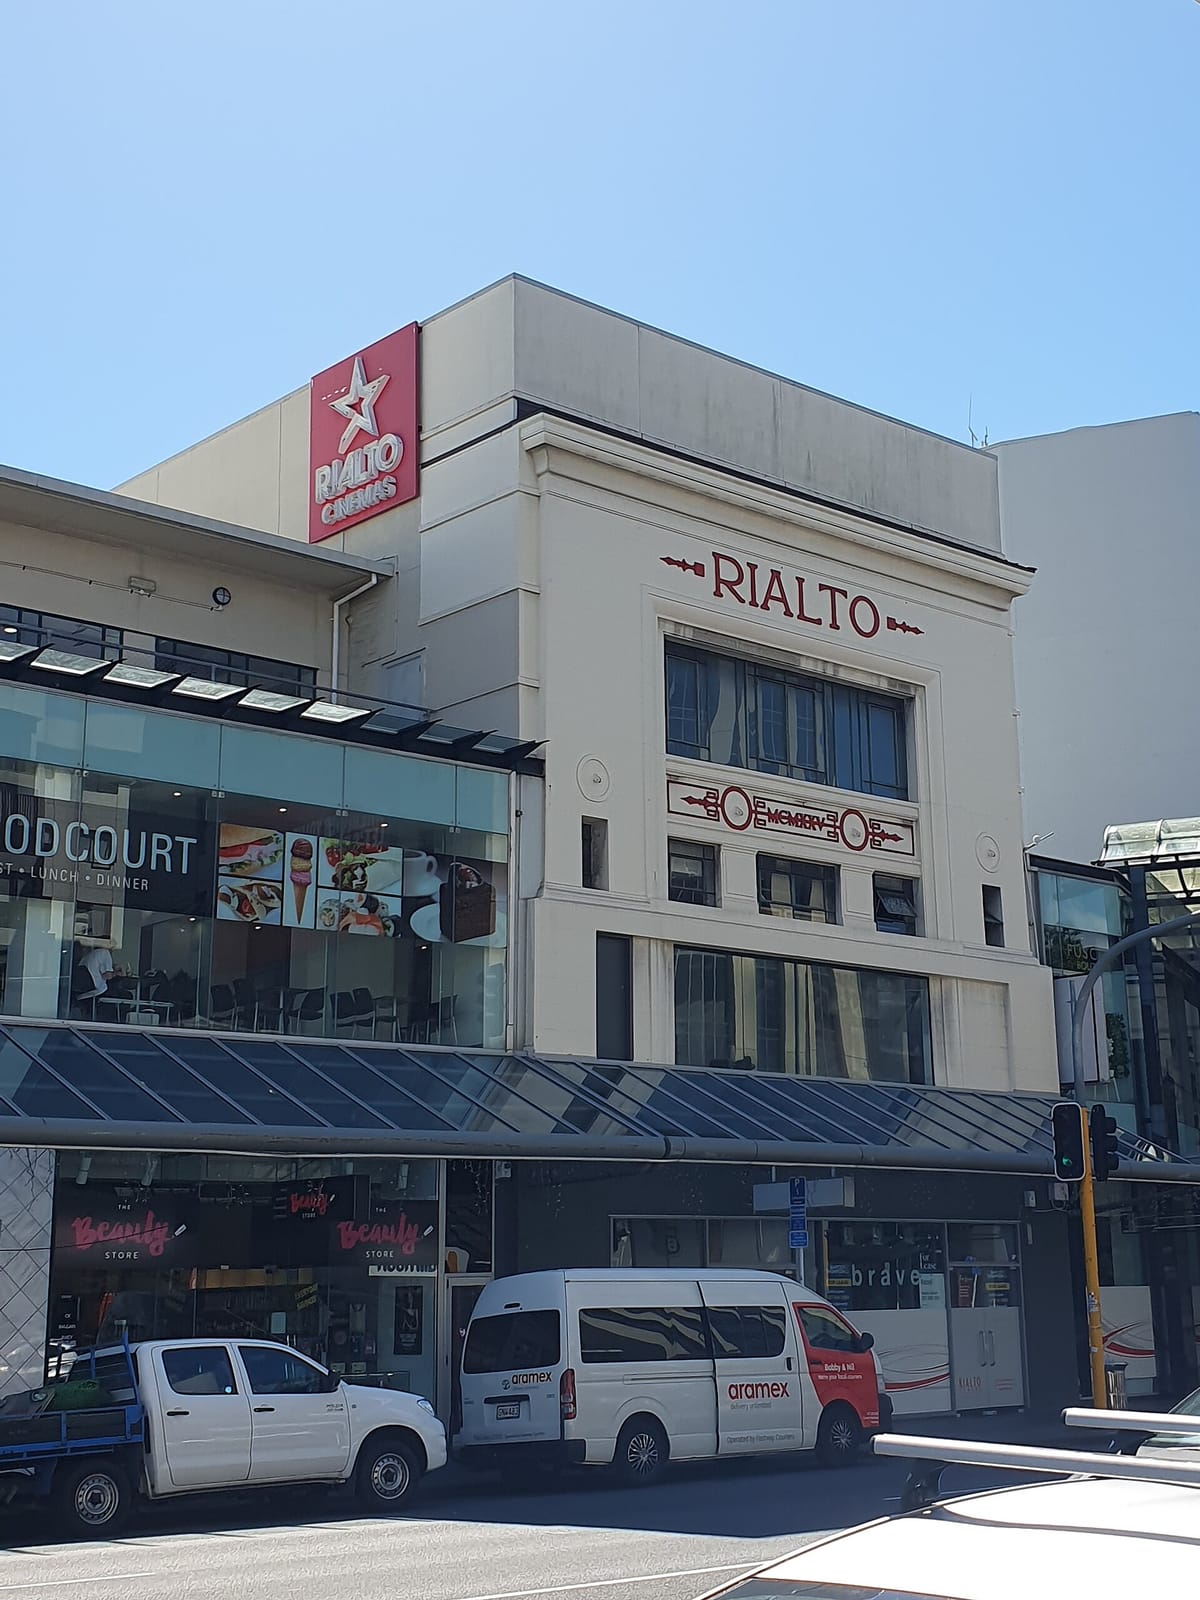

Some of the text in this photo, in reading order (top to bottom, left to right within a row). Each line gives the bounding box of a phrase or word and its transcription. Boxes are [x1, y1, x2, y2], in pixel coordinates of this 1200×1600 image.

[315, 433, 403, 504] RIALTO
[321, 475, 397, 525] CINEMAS
[712, 551, 880, 638] RIALTO
[30, 865, 79, 883] LUNCH
[96, 873, 150, 891] DINNER
[72, 1210, 169, 1257] Beauty
[337, 1212, 419, 1255] Beauty
[104, 1251, 140, 1259] STORE
[365, 1250, 395, 1258] STORE
[511, 1371, 552, 1385] aramex
[728, 1382, 790, 1400] aramex
